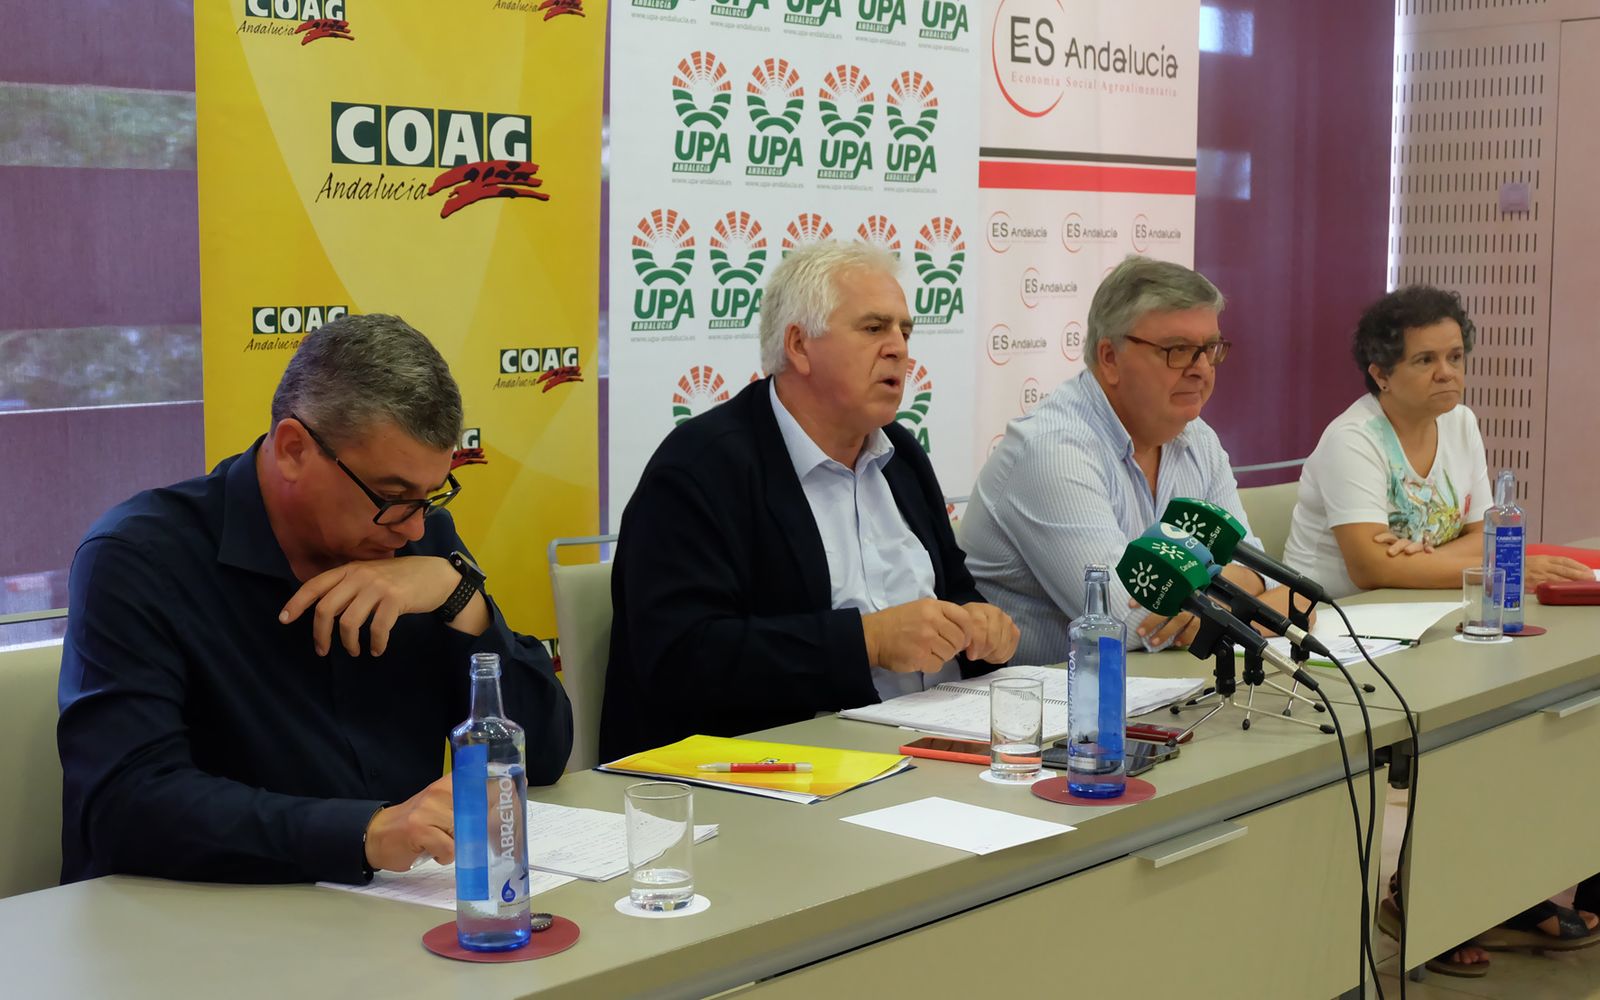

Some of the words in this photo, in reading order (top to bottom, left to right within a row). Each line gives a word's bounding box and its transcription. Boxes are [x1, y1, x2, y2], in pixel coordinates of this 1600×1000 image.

[248, 0, 344, 21] COAG
[859, 0, 906, 25] UPA
[922, 0, 969, 33] UPA
[1010, 16, 1055, 67] ES
[1064, 37, 1179, 79] Andalucía
[336, 105, 527, 167] COAG
[674, 130, 731, 163] UPA
[748, 135, 804, 167] UPA
[820, 139, 873, 170] UPA
[886, 143, 937, 173] UPA
[992, 223, 1009, 238] ES
[1066, 223, 1081, 238] ES
[1135, 224, 1147, 239] ES
[1025, 278, 1038, 293] ES
[634, 288, 695, 319] UPA
[711, 288, 763, 318] UPA
[915, 287, 964, 314] UPA
[992, 335, 1009, 350] ES
[1066, 332, 1080, 347] ES
[501, 347, 578, 373] COAG
[1024, 388, 1038, 403] ES
